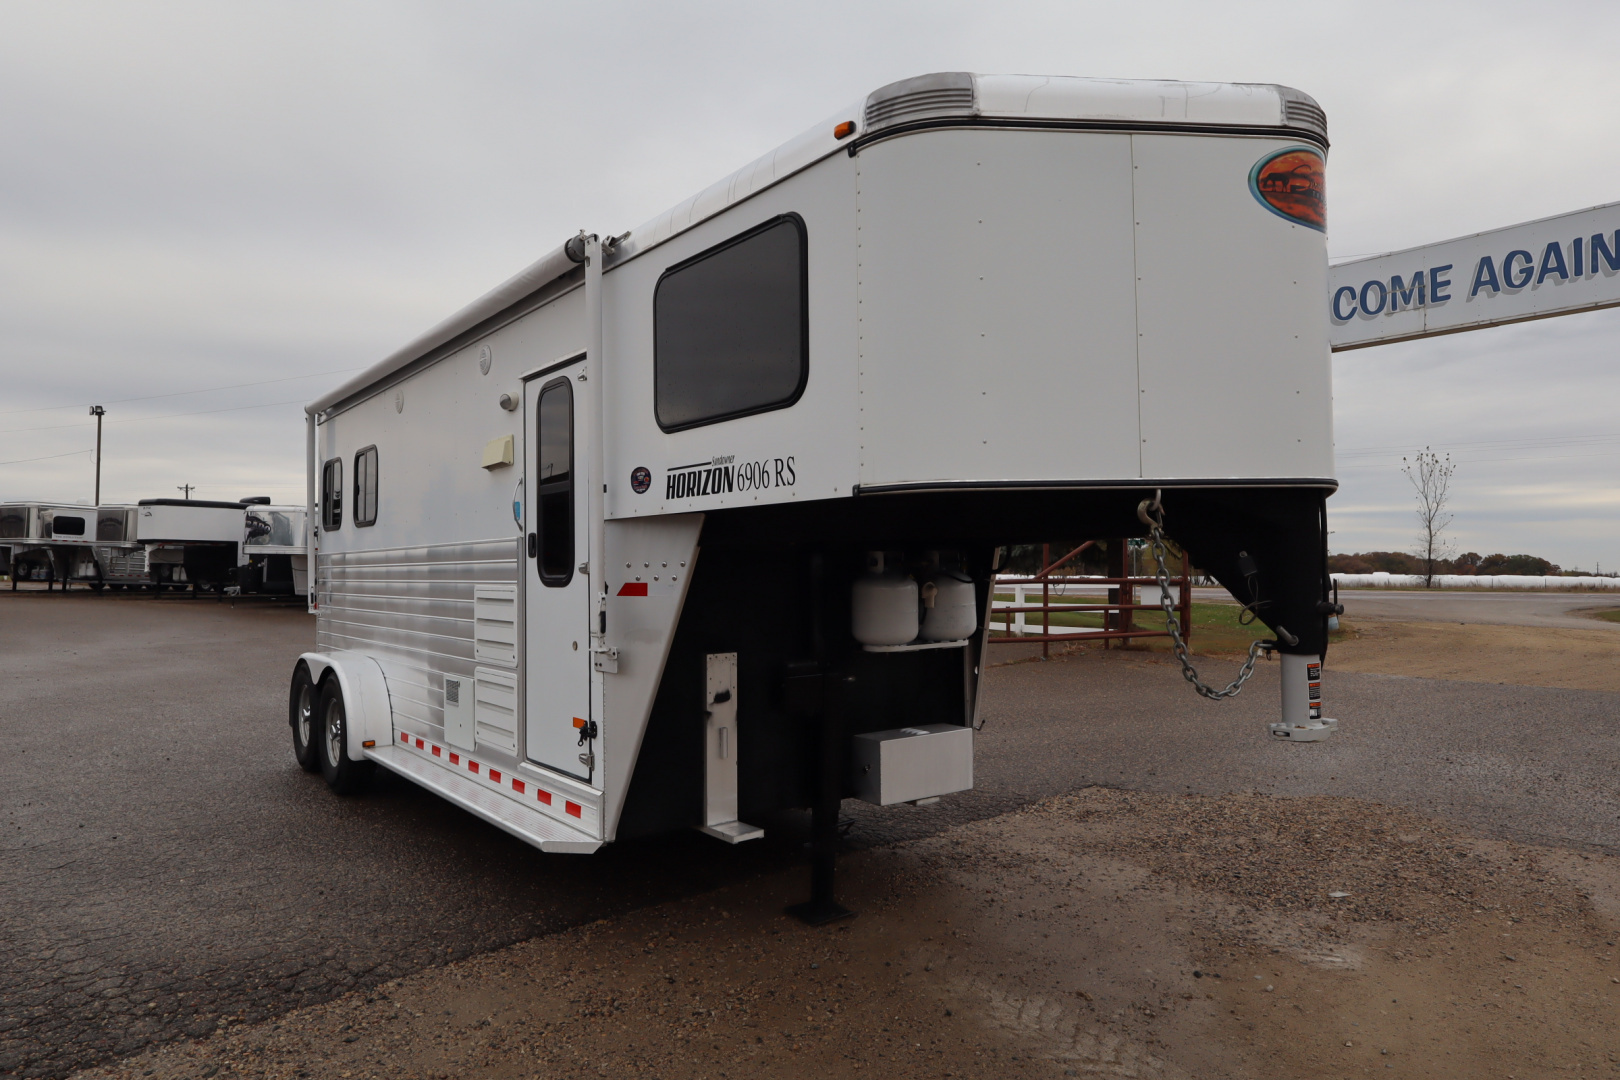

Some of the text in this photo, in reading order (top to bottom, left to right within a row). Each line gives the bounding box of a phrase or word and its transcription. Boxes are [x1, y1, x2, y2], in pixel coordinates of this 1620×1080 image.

[1332, 229, 1620, 321] COME AGAIN
[666, 465, 735, 500] HORIZON
[737, 459, 770, 492] 6906
[774, 456, 796, 488] RS
